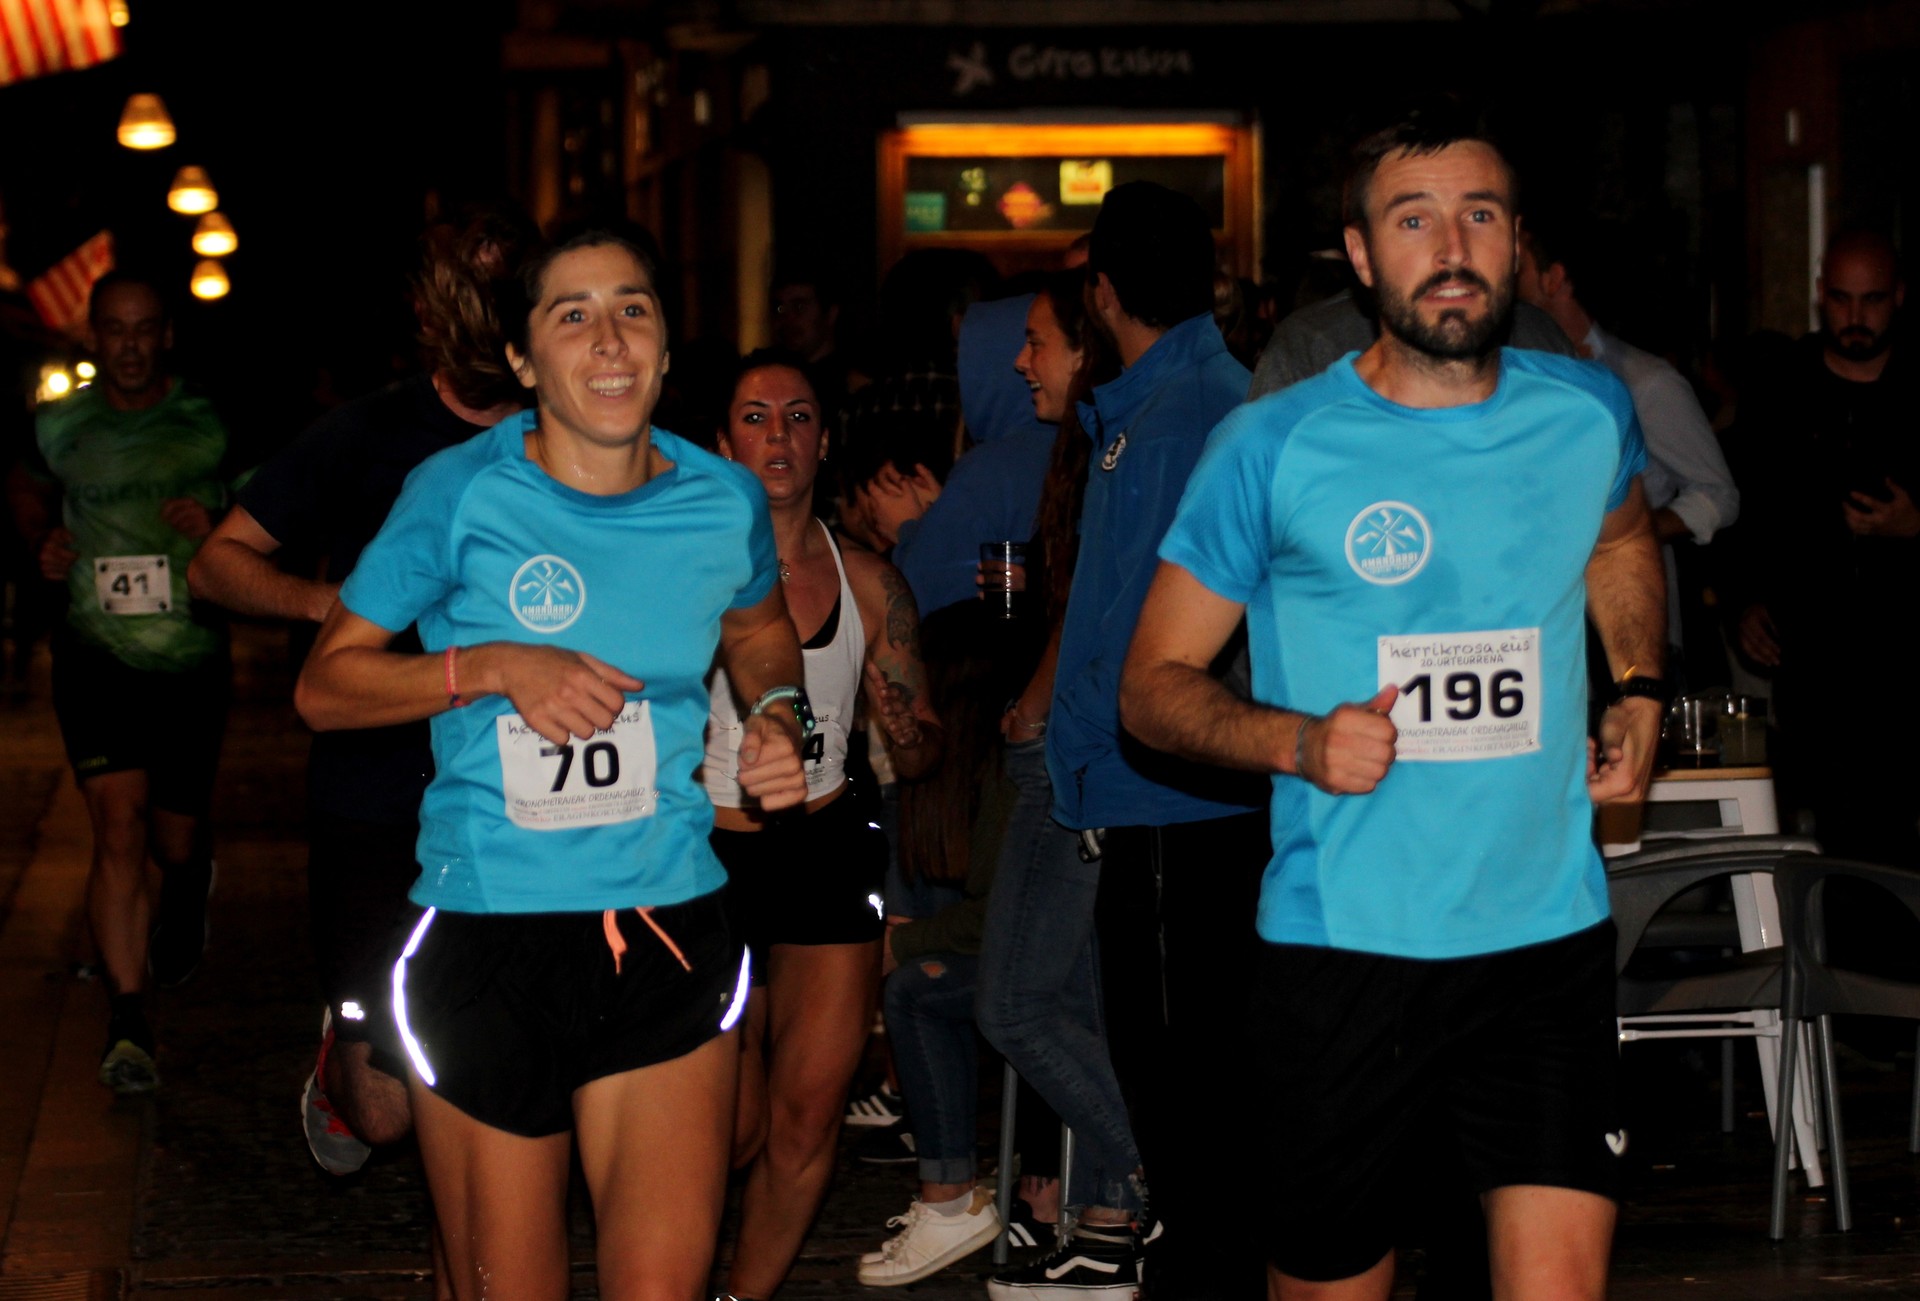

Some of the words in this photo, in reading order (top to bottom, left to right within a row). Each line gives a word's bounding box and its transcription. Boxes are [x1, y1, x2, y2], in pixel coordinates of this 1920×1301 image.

[111, 573, 148, 596] 41
[1400, 668, 1524, 722] 196
[539, 741, 620, 792] 70
